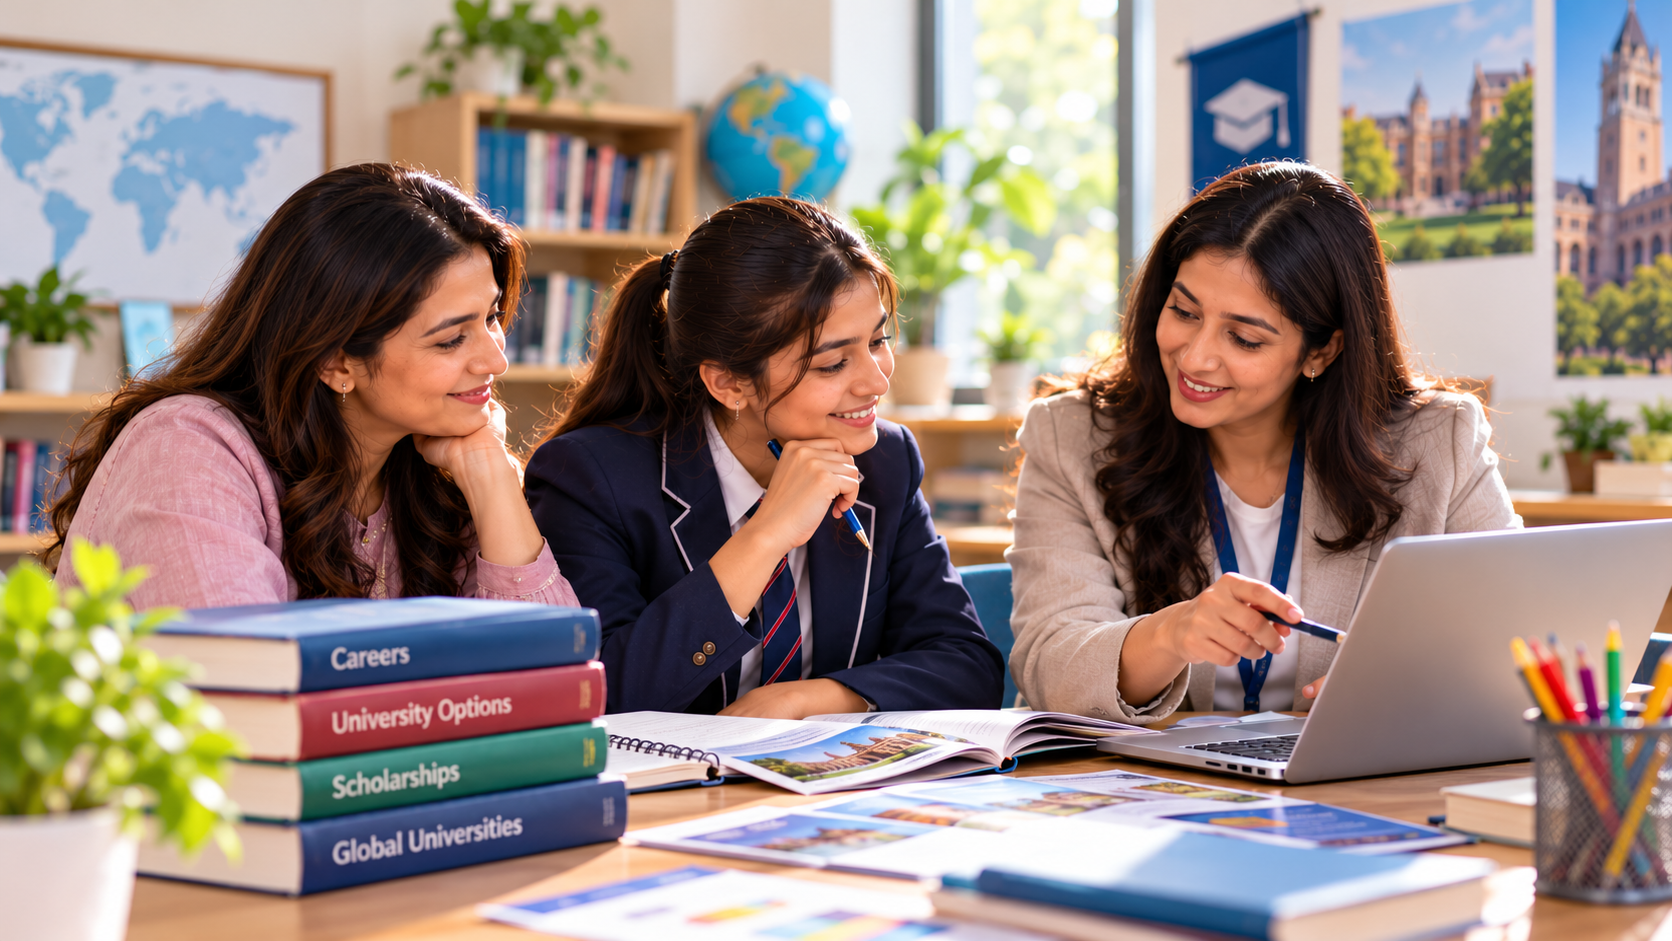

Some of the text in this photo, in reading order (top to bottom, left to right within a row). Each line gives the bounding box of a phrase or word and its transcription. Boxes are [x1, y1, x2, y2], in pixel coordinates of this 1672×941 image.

[330, 646, 411, 671] Careers
[331, 695, 513, 735] University Options
[332, 761, 461, 800] Scholarships
[332, 814, 523, 865] Global Universities
